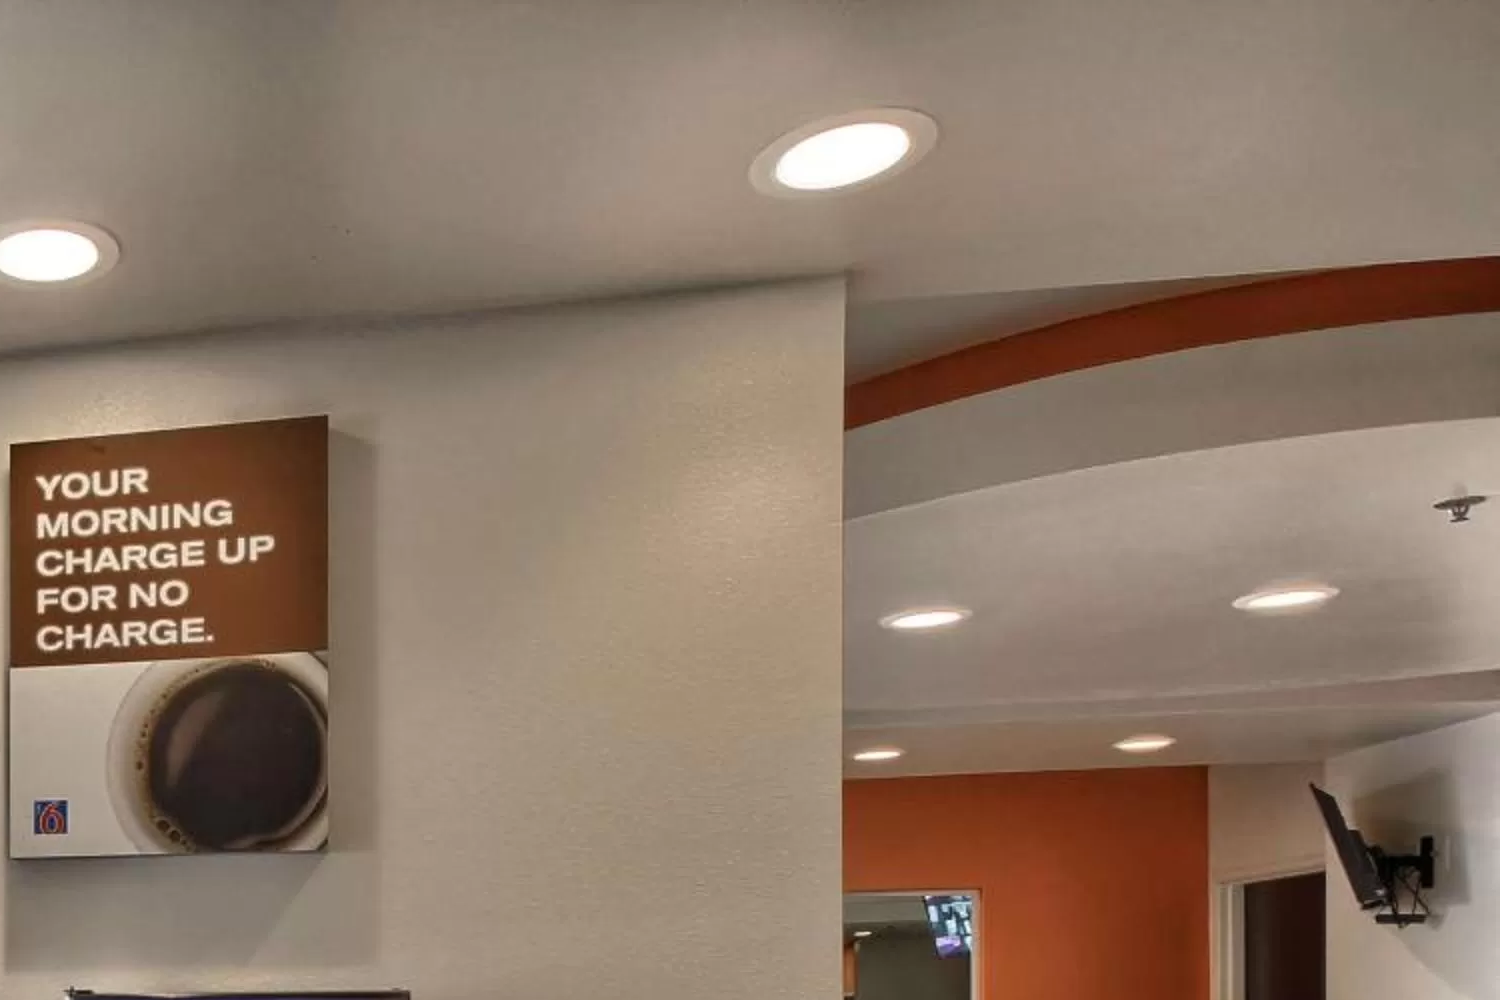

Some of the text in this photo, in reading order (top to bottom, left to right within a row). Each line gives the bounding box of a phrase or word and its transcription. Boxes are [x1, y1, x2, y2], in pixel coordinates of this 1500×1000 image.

[35, 467, 149, 501] YOUR
[36, 499, 234, 539] MORNING
[36, 535, 275, 577] CHARGE UP
[37, 579, 189, 614] FOR NO
[36, 616, 214, 652] CHARGE.
